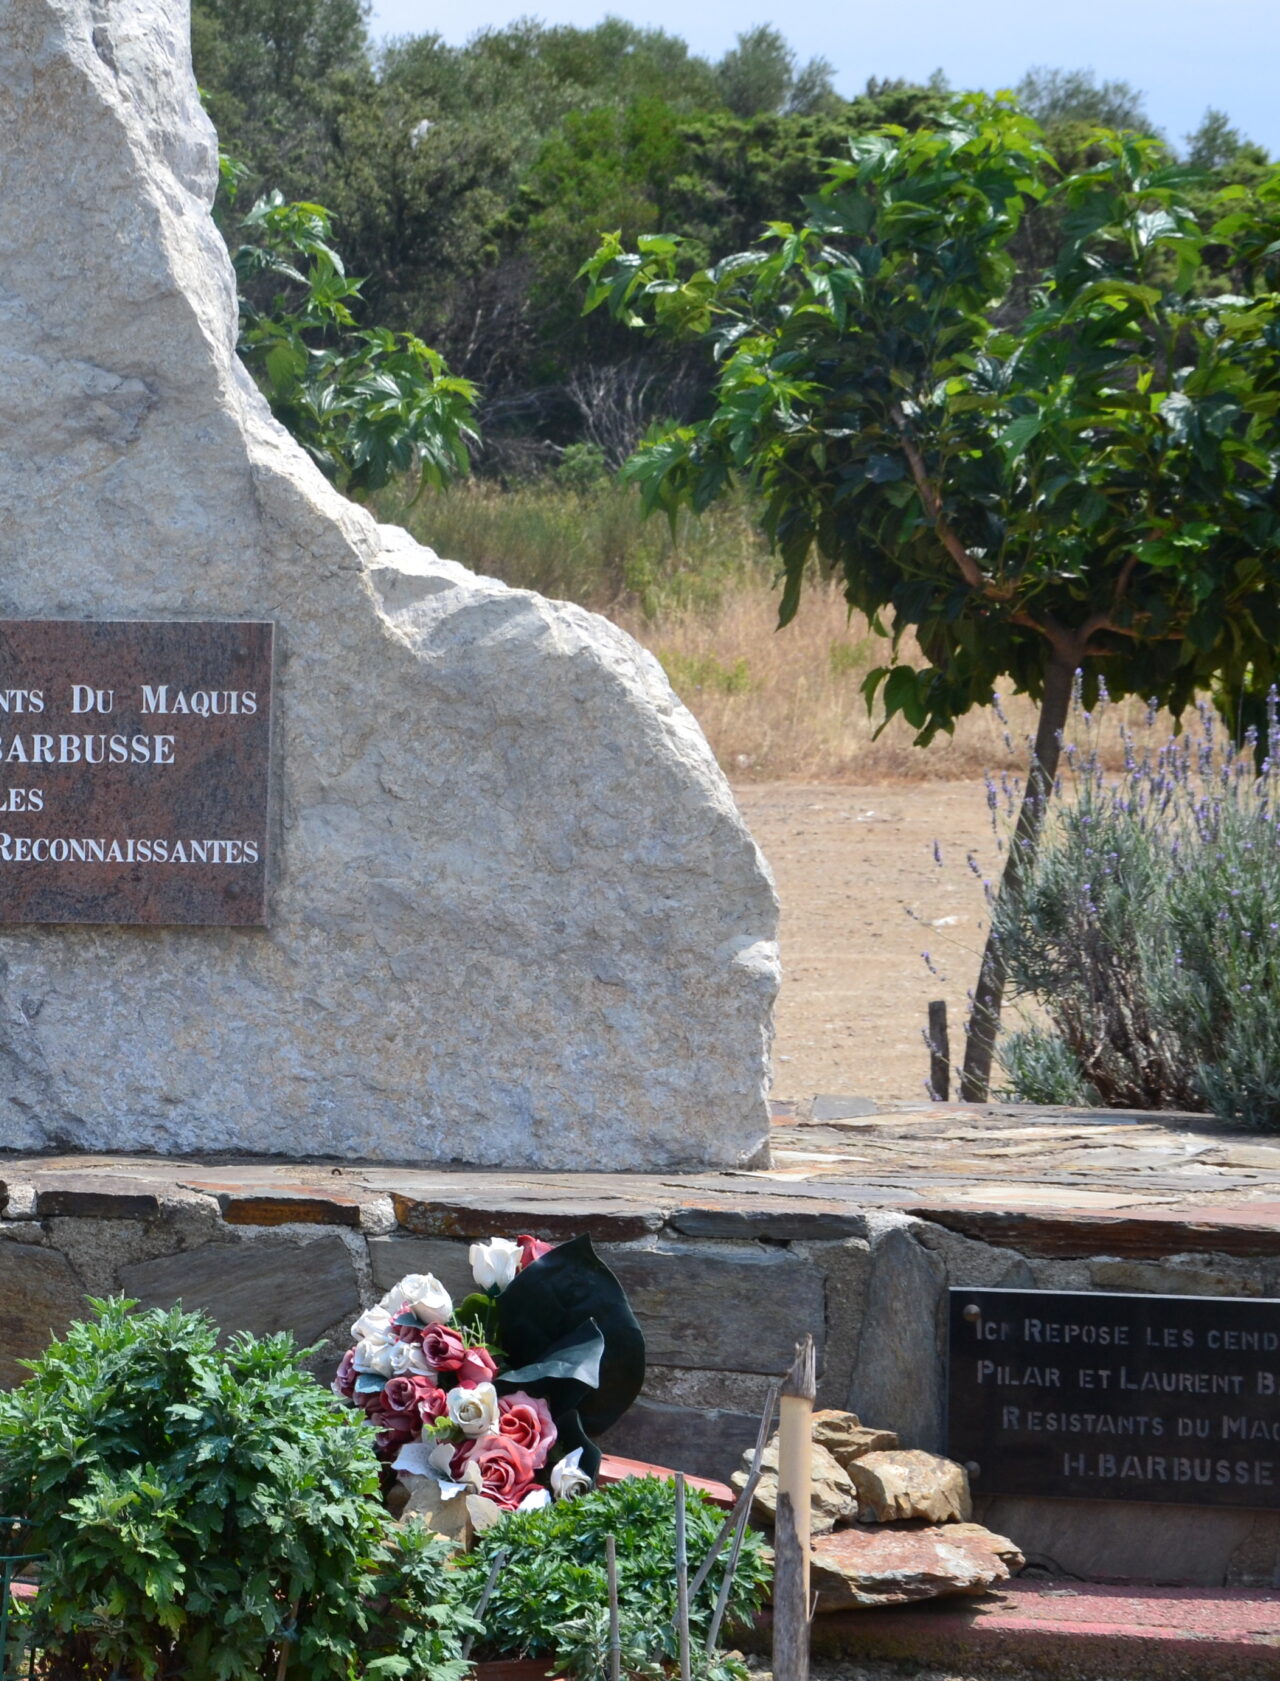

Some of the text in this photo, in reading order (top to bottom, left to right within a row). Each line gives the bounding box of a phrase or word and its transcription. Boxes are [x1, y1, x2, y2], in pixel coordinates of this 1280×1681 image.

[70, 684, 114, 714] DU
[140, 684, 257, 718] MAQUIS
[1024, 1318, 1129, 1345] REPOSE
[1146, 1326, 1195, 1348] LES
[976, 1359, 1280, 1395] PILAR ET LAURENT B
[1002, 1406, 1164, 1436] RESISTANTS
[1178, 1417, 1209, 1438] DU
